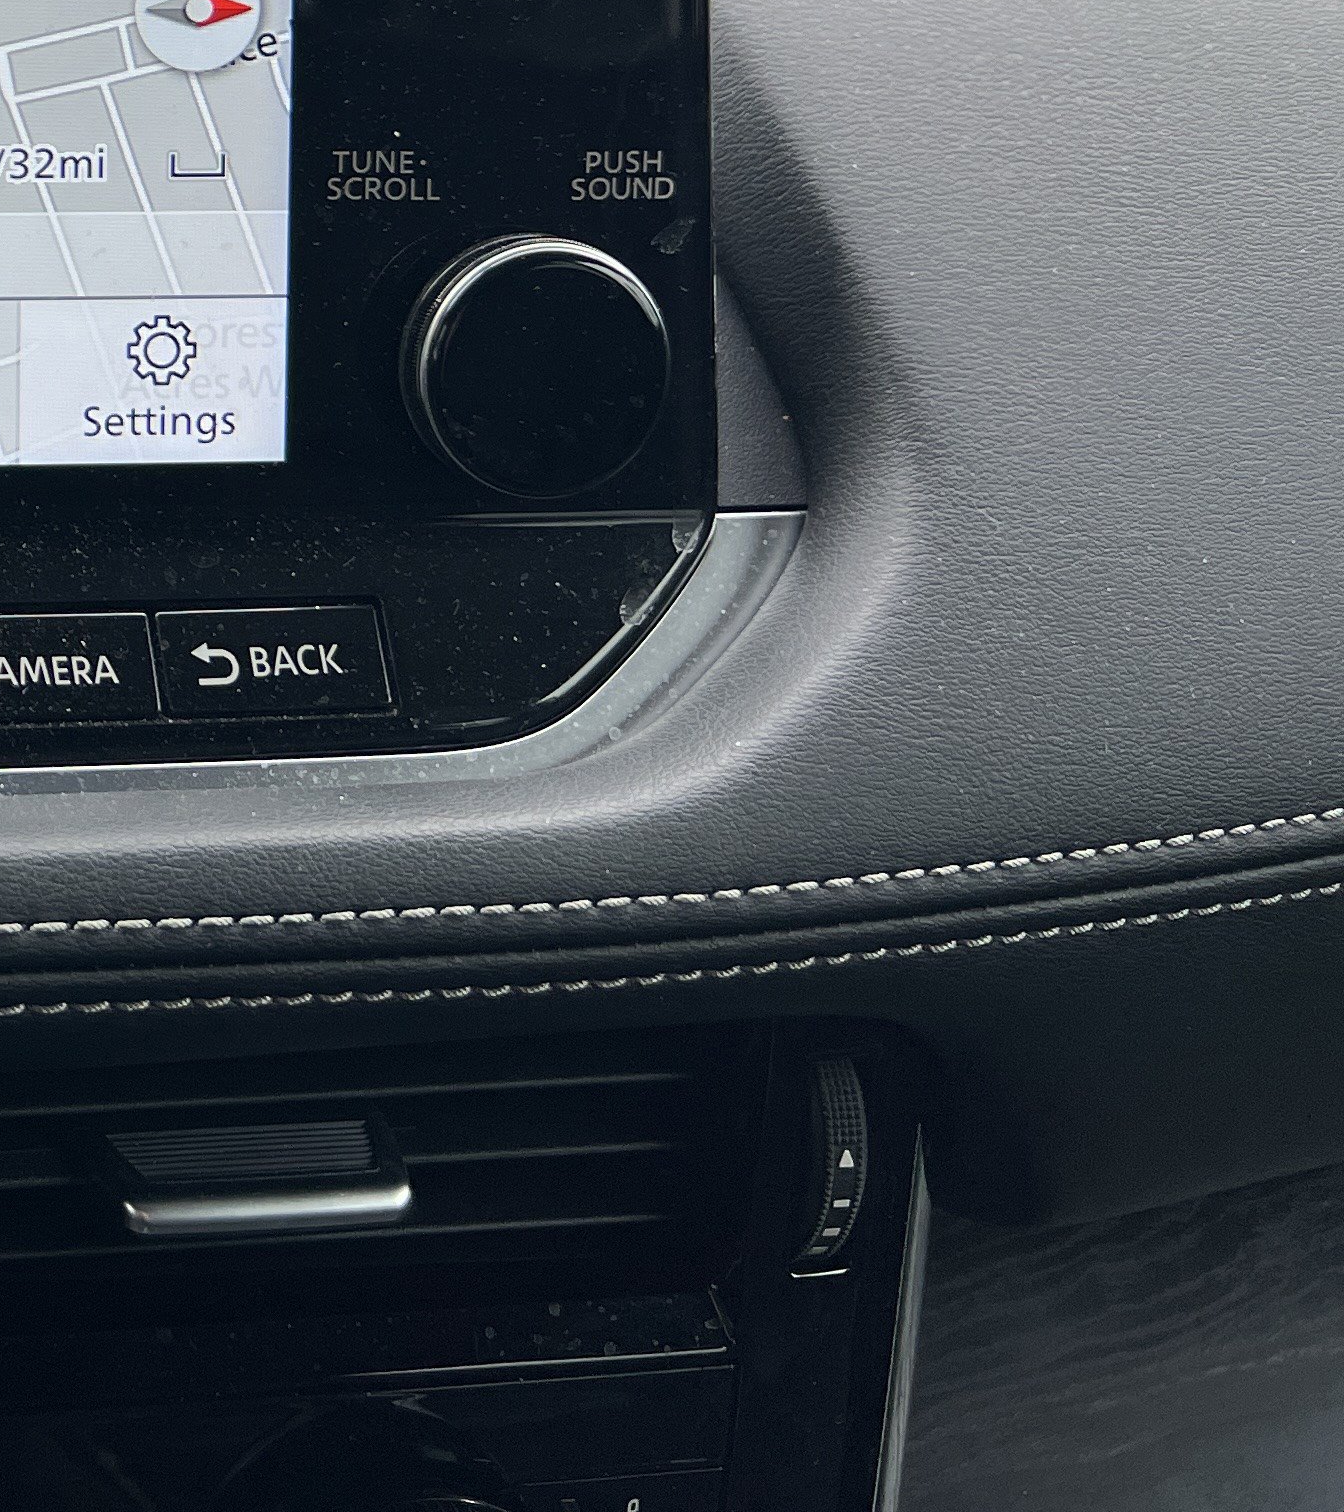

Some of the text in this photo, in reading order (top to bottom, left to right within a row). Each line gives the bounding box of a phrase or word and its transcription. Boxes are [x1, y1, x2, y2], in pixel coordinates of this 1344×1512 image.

[584, 150, 663, 174] PUSH
[326, 177, 441, 202] SCROLL
[570, 177, 675, 202] SOUND
[83, 404, 236, 444] Settings
[250, 644, 344, 679] BACK
